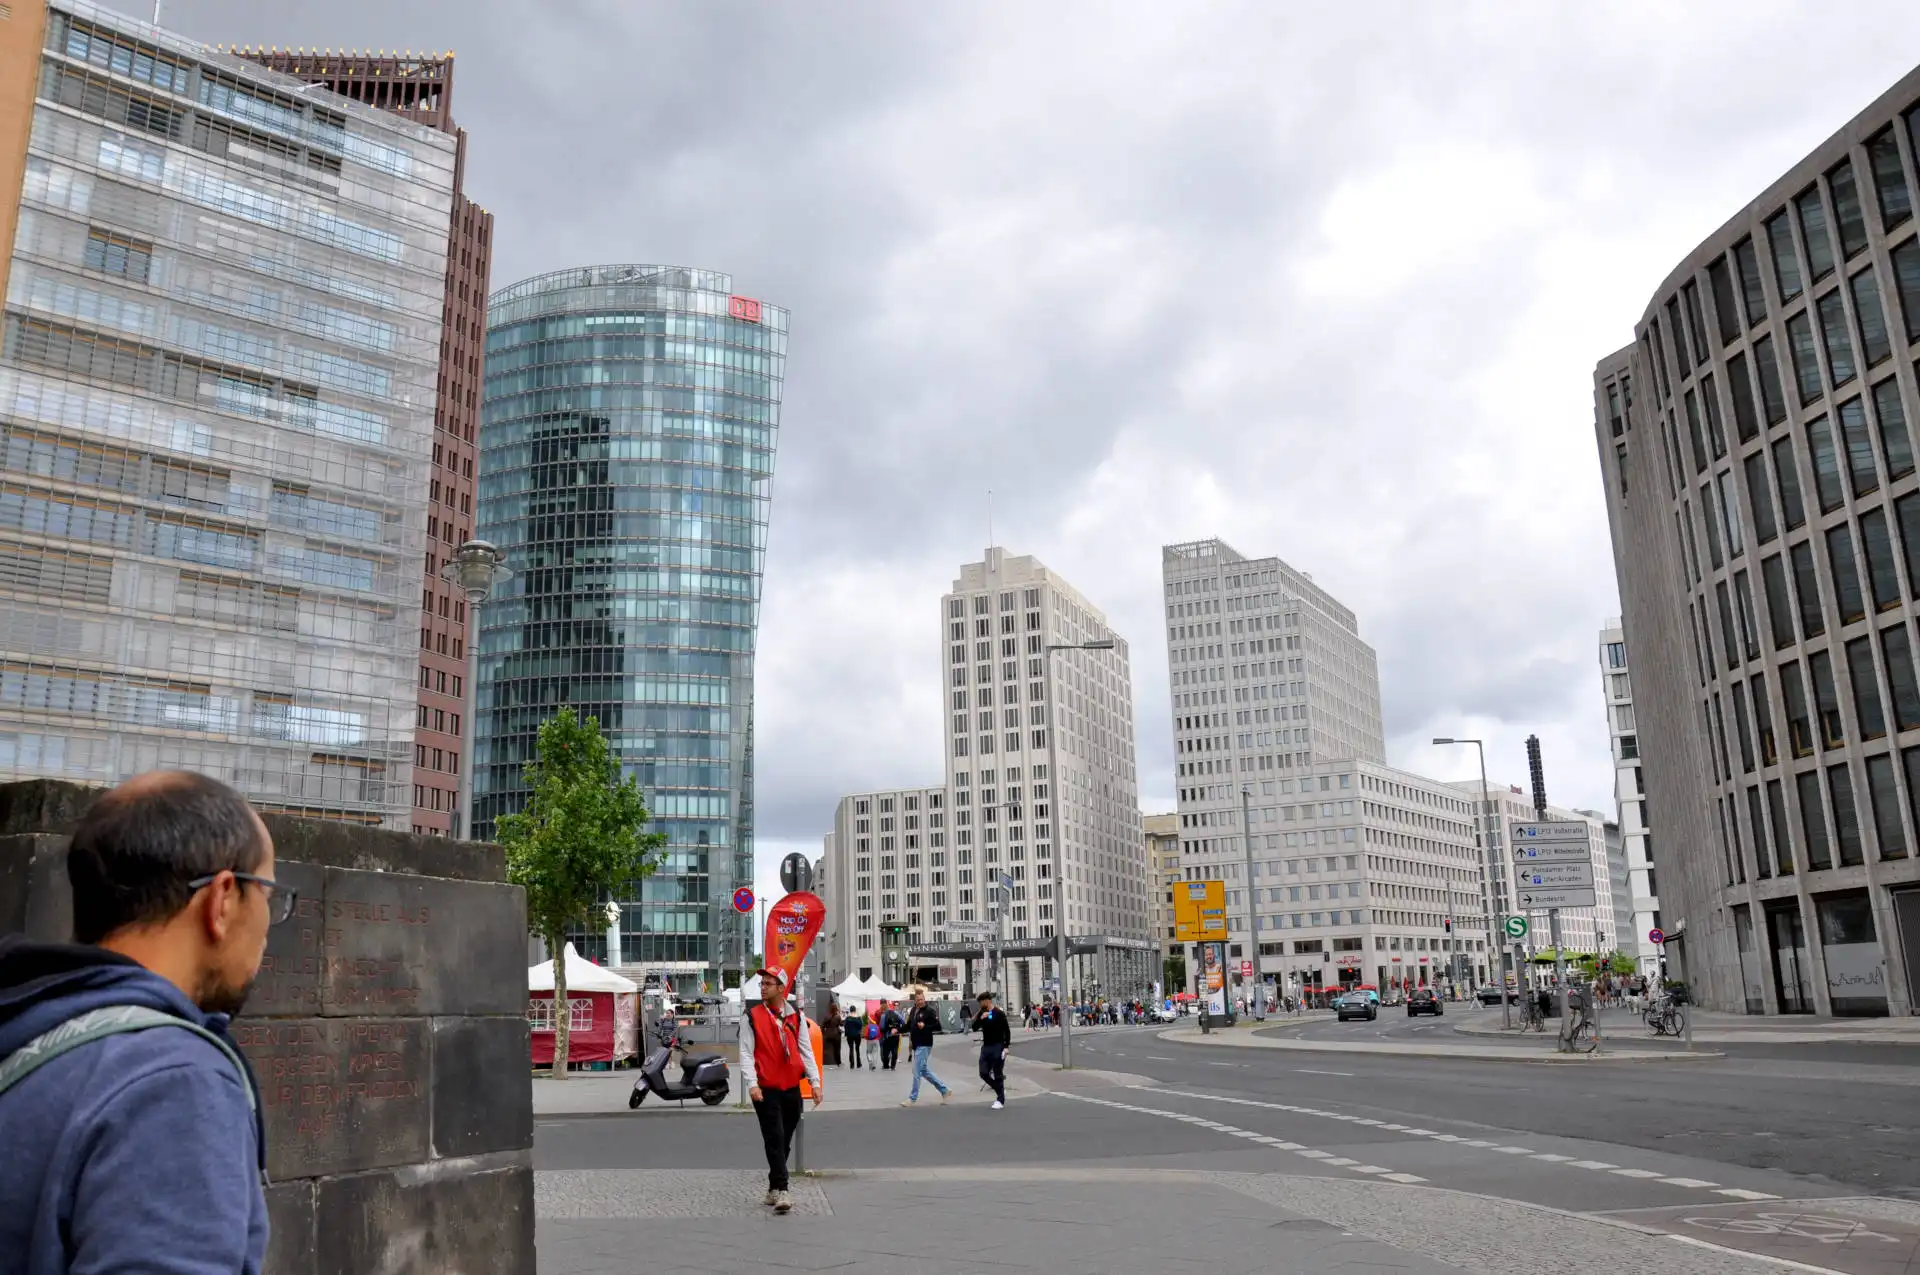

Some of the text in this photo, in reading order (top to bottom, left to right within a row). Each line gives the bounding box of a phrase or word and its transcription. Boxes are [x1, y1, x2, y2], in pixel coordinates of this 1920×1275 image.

[732, 298, 759, 319] DB
[780, 916, 796, 926] Hop
[906, 943, 954, 953] AHNHOF
